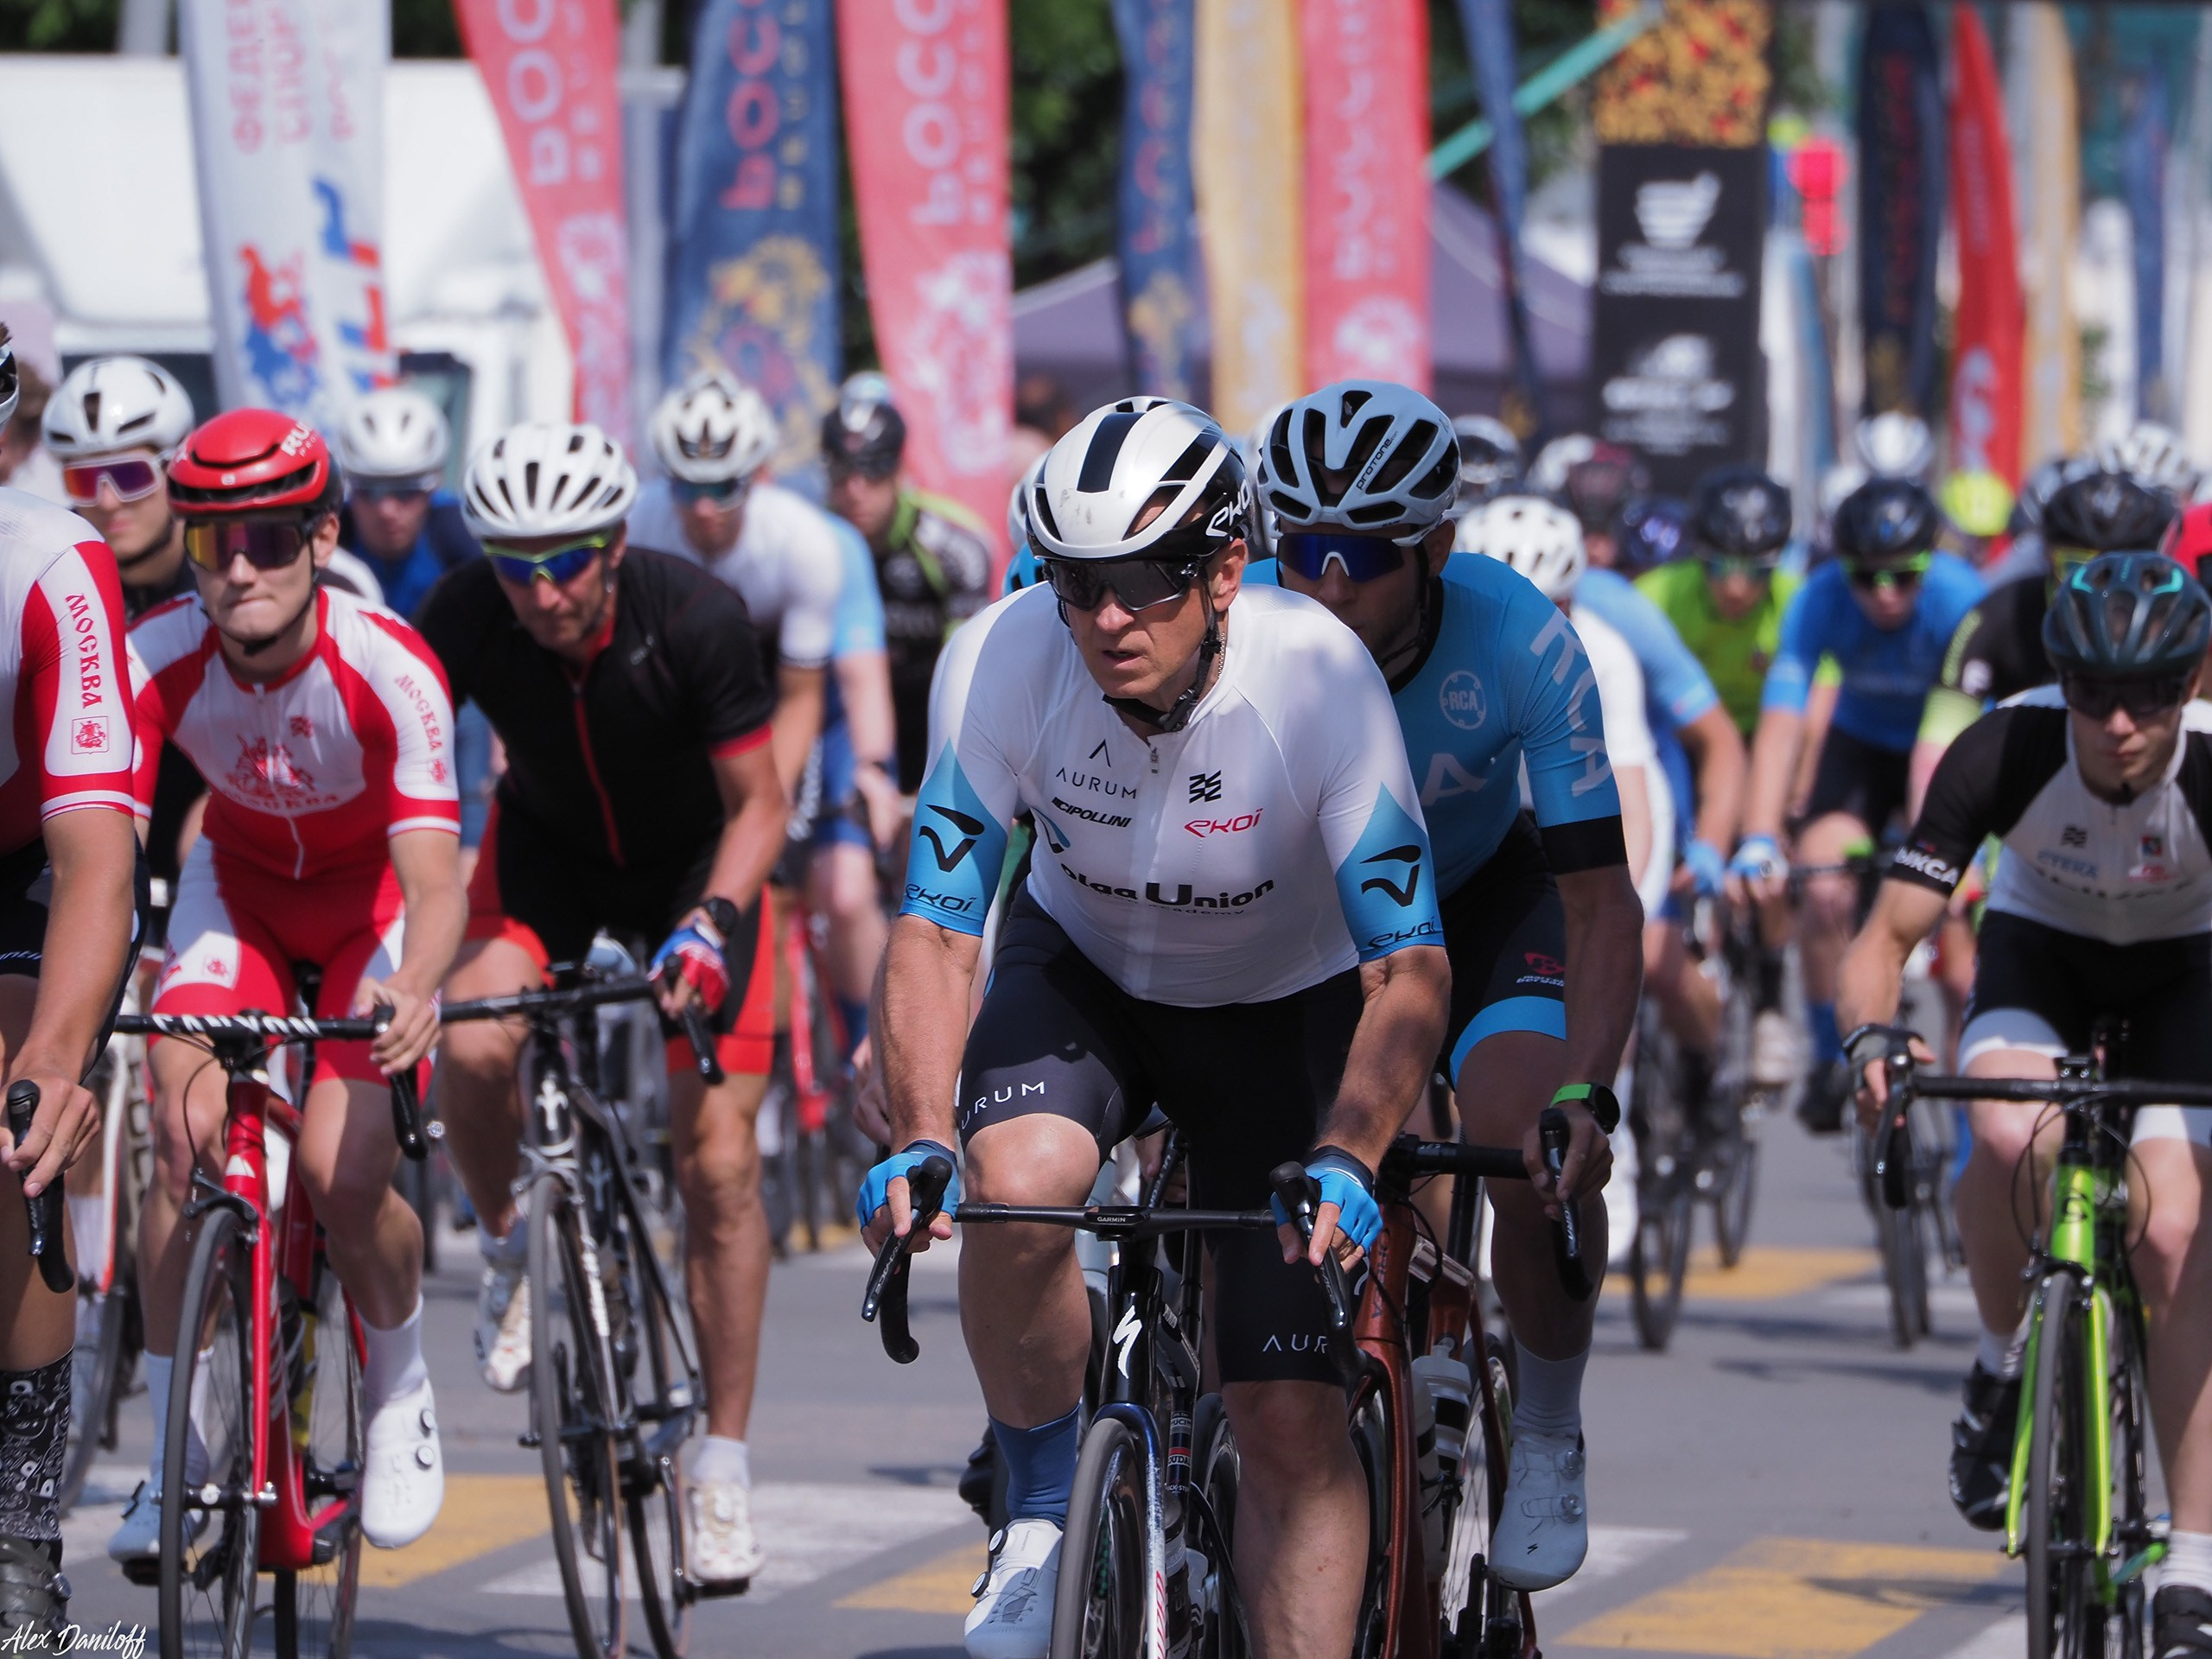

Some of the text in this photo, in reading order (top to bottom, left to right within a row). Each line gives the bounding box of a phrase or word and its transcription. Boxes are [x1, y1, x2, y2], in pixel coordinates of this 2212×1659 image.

[65, 594, 103, 709] МОСКВА
[395, 676, 442, 750] МОСКВА
[1448, 690, 1478, 712] RCA
[1056, 767, 1137, 799] AURUM
[1054, 798, 1133, 828] CIPOLLINI
[1146, 879, 1274, 909] Union
